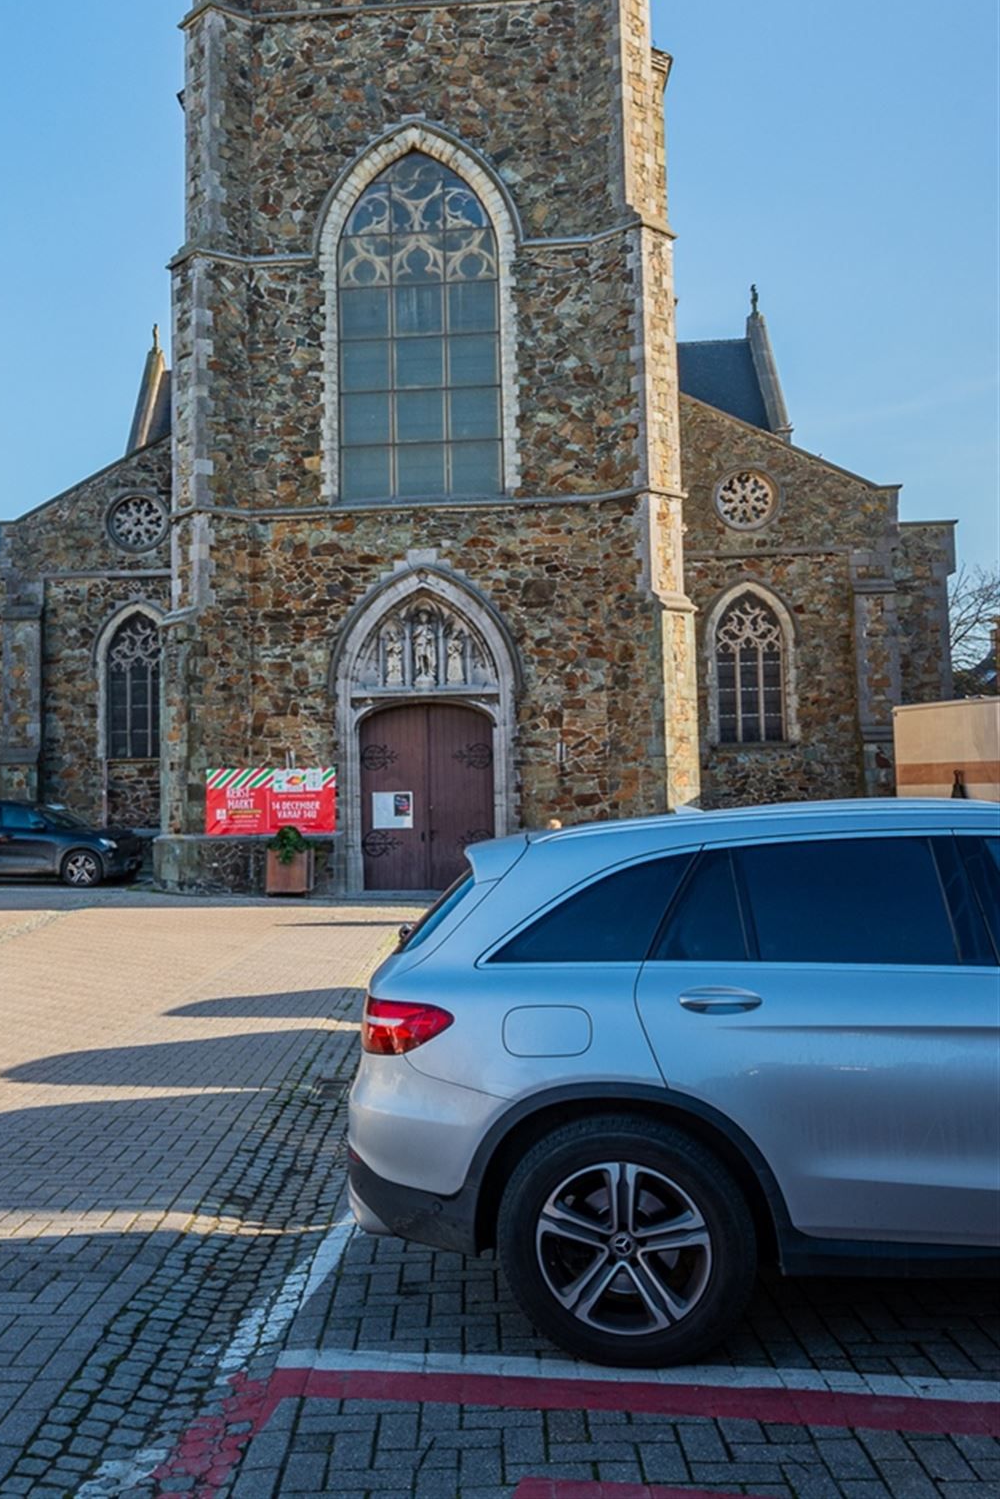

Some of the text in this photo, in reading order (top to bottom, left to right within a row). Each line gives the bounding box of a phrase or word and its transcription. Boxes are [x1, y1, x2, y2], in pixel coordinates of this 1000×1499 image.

[227, 799, 254, 809] MARKT
[282, 801, 320, 810] DECEMBER
[277, 810, 301, 819] VANAF
